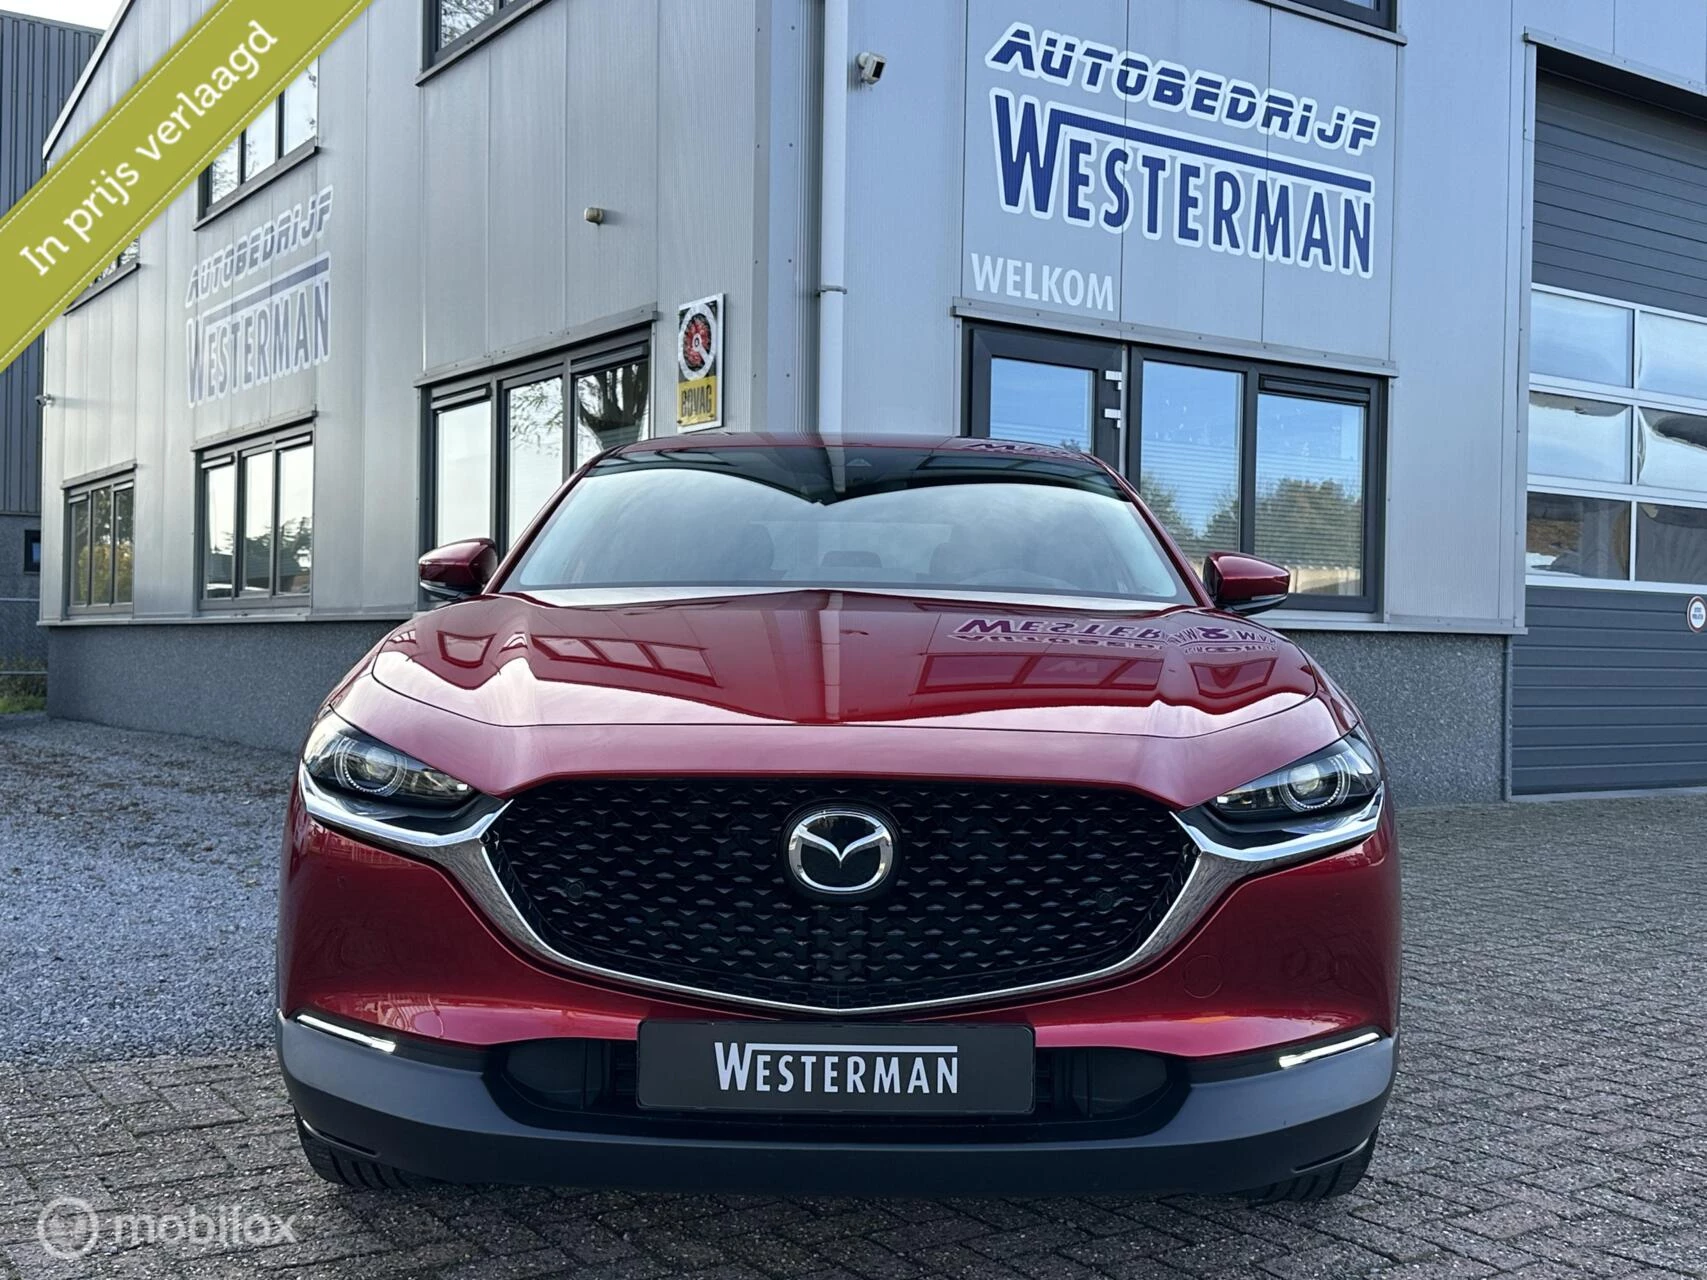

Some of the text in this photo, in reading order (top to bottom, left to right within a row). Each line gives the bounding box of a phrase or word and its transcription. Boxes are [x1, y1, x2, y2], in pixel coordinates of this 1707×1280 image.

[988, 26, 1378, 154] AUTOBEDRIJF
[992, 92, 1375, 275] WESTERMAN
[187, 186, 332, 306] AUTOBEDRIJF
[970, 252, 1114, 312] WELKOM
[188, 256, 331, 406] WESTERMAN
[681, 384, 712, 417] BOVAG
[713, 1041, 959, 1095] WESTERMAN
